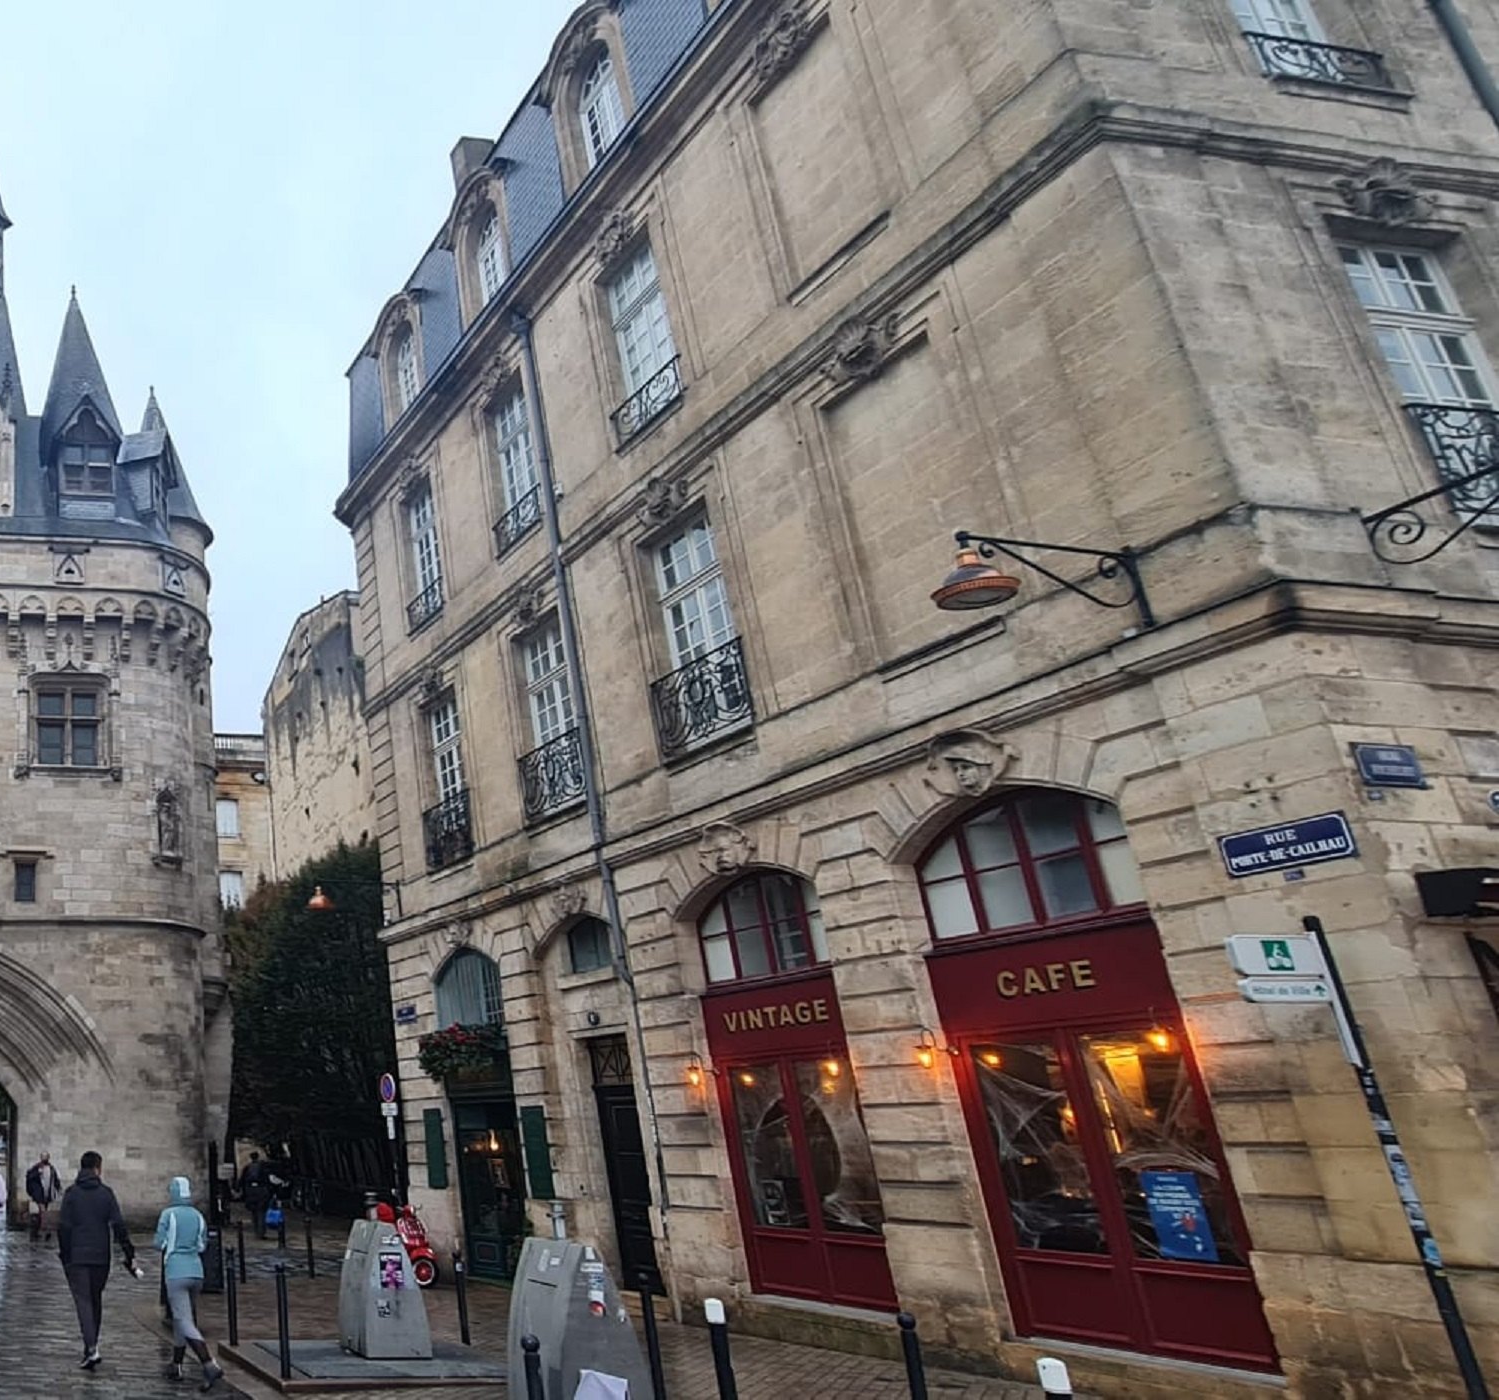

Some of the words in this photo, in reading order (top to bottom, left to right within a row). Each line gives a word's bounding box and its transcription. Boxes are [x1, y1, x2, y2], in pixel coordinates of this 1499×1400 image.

[1230, 836, 1346, 869] PORTE-DE-CAILHAU
[1263, 829, 1298, 846] RUE
[996, 959, 1096, 996] CAFE
[723, 999, 830, 1032] VINTAGE
